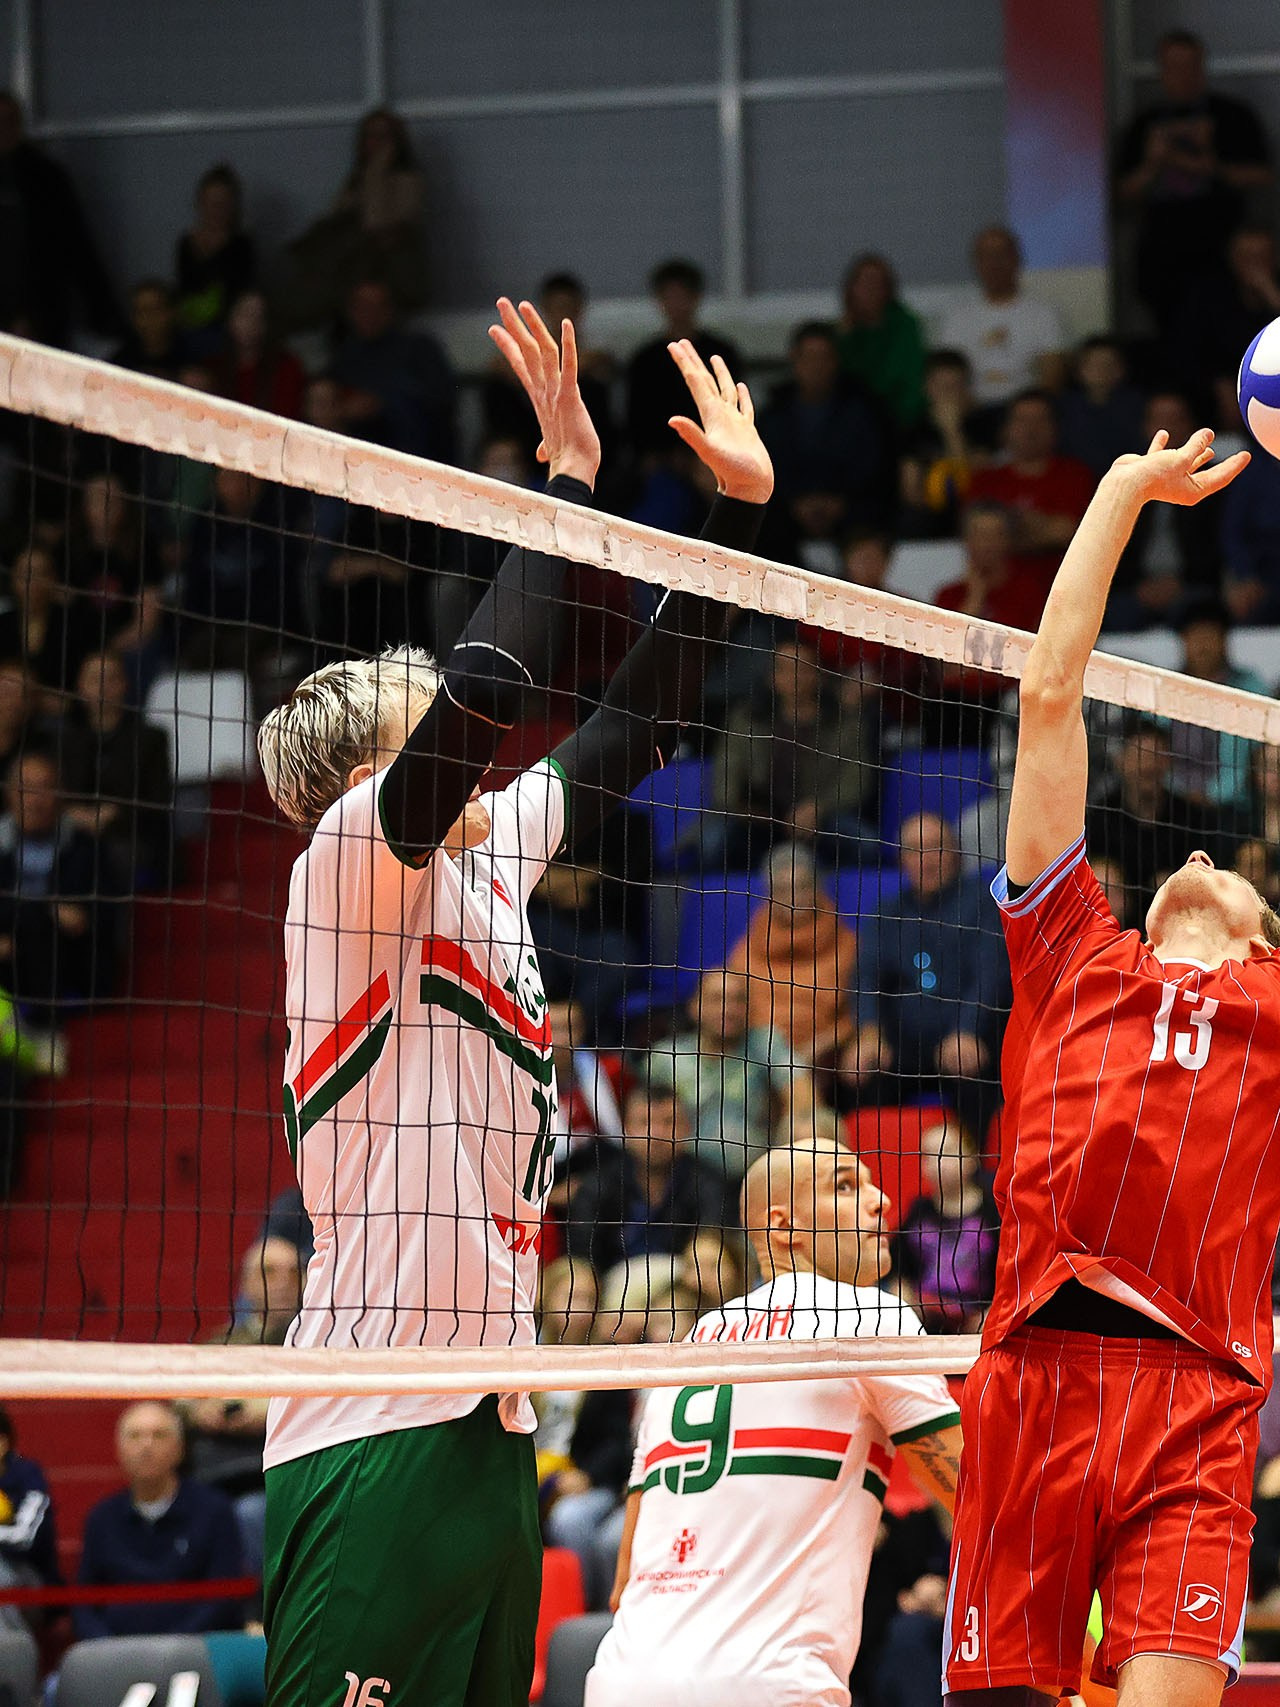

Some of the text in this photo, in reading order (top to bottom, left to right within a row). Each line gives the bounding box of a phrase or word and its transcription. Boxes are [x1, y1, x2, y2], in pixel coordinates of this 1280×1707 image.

[1149, 982, 1220, 1071] 13
[1231, 1340, 1253, 1359] GS
[671, 1384, 733, 1495] 9
[954, 1605, 980, 1663] 3
